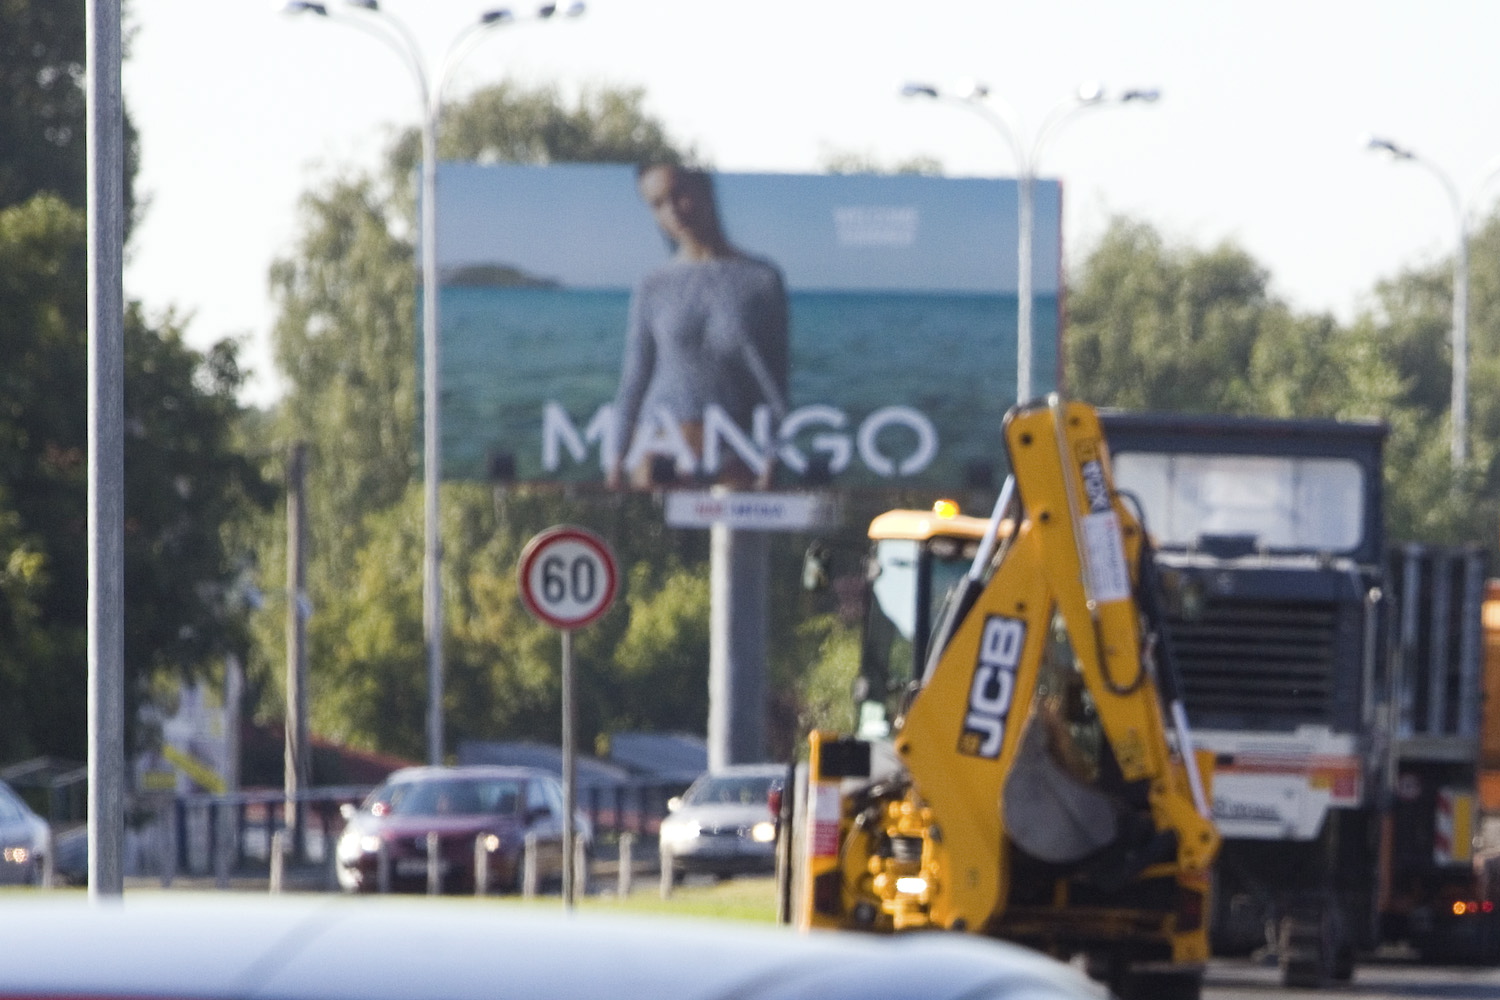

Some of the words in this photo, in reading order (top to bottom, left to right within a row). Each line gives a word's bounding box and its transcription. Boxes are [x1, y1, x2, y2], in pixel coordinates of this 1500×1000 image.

[541, 403, 939, 477] MANGO
[541, 554, 595, 605] 60
[965, 615, 1025, 758] JCB
